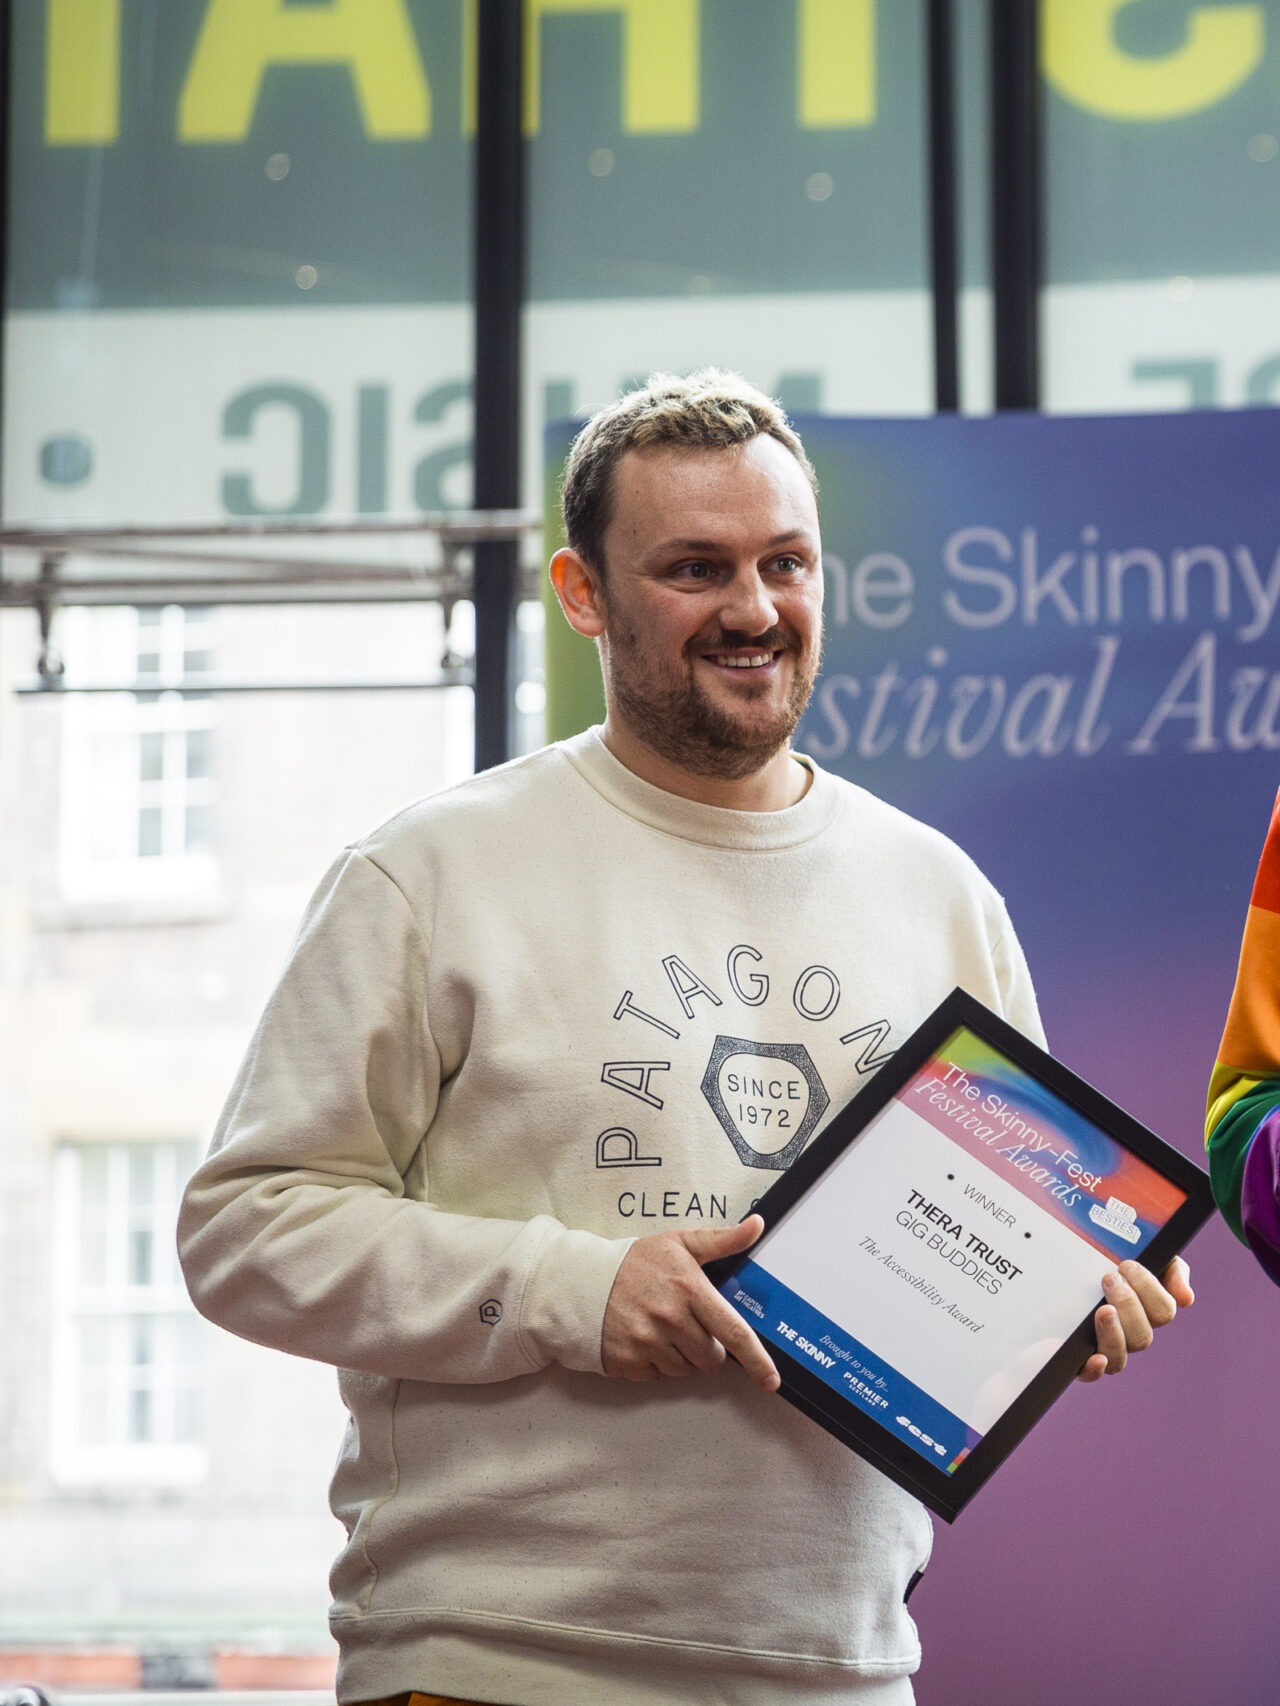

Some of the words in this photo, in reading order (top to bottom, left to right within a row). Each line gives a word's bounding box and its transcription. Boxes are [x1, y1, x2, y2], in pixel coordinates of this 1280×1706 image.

[727, 1073, 801, 1100] SINCE
[942, 1061, 981, 1101] The
[739, 1104, 791, 1128] 1972
[914, 1077, 1008, 1146] Festival
[995, 1143, 1082, 1207] Awards
[618, 1191, 727, 1219] CLEAN
[963, 1183, 1017, 1229] WINNER
[1091, 1206, 1135, 1235] BESTIES
[1110, 1198, 1133, 1217] THE
[896, 1210, 929, 1240] GIG
[926, 1233, 1003, 1295] BUDDIES
[906, 1189, 963, 1240] THERA
[965, 1233, 1023, 1281] TRUST
[858, 1236, 881, 1257] The
[878, 1254, 946, 1306] Accessibility
[941, 1303, 985, 1333] Award
[776, 1321, 799, 1341] THE
[795, 1336, 837, 1369] SKINNY
[819, 1334, 854, 1361] Brought
[850, 1359, 861, 1369] to
[856, 1366, 876, 1380] you
[843, 1371, 889, 1409] PREMIER
[895, 1415, 948, 1456] fest
